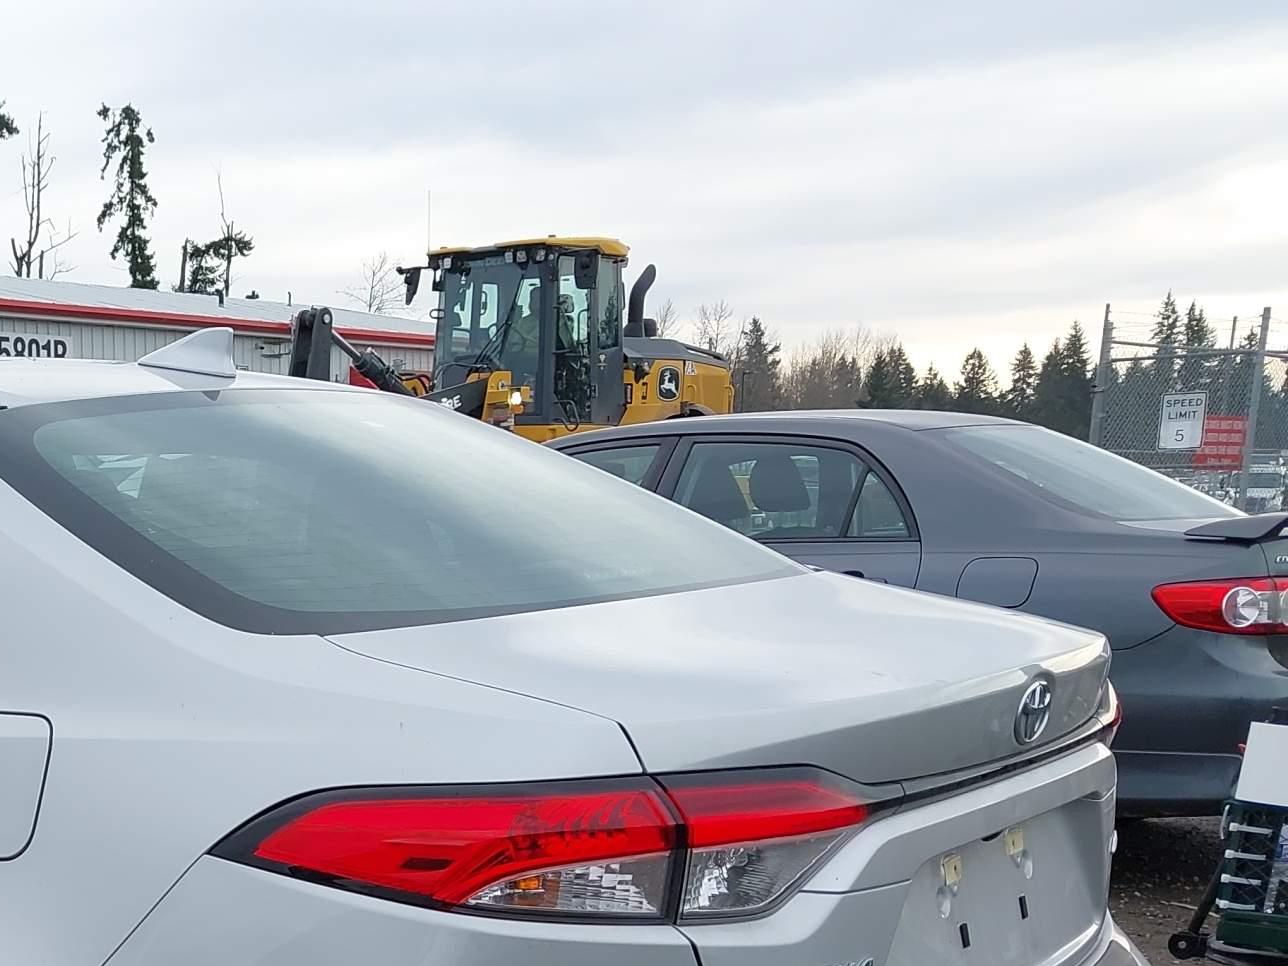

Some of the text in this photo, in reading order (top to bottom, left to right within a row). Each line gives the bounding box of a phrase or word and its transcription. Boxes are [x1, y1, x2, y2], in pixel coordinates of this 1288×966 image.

[1165, 398, 1203, 407] SPEED
[1167, 410, 1198, 420] LIMIT
[1174, 429, 1185, 442] 5
